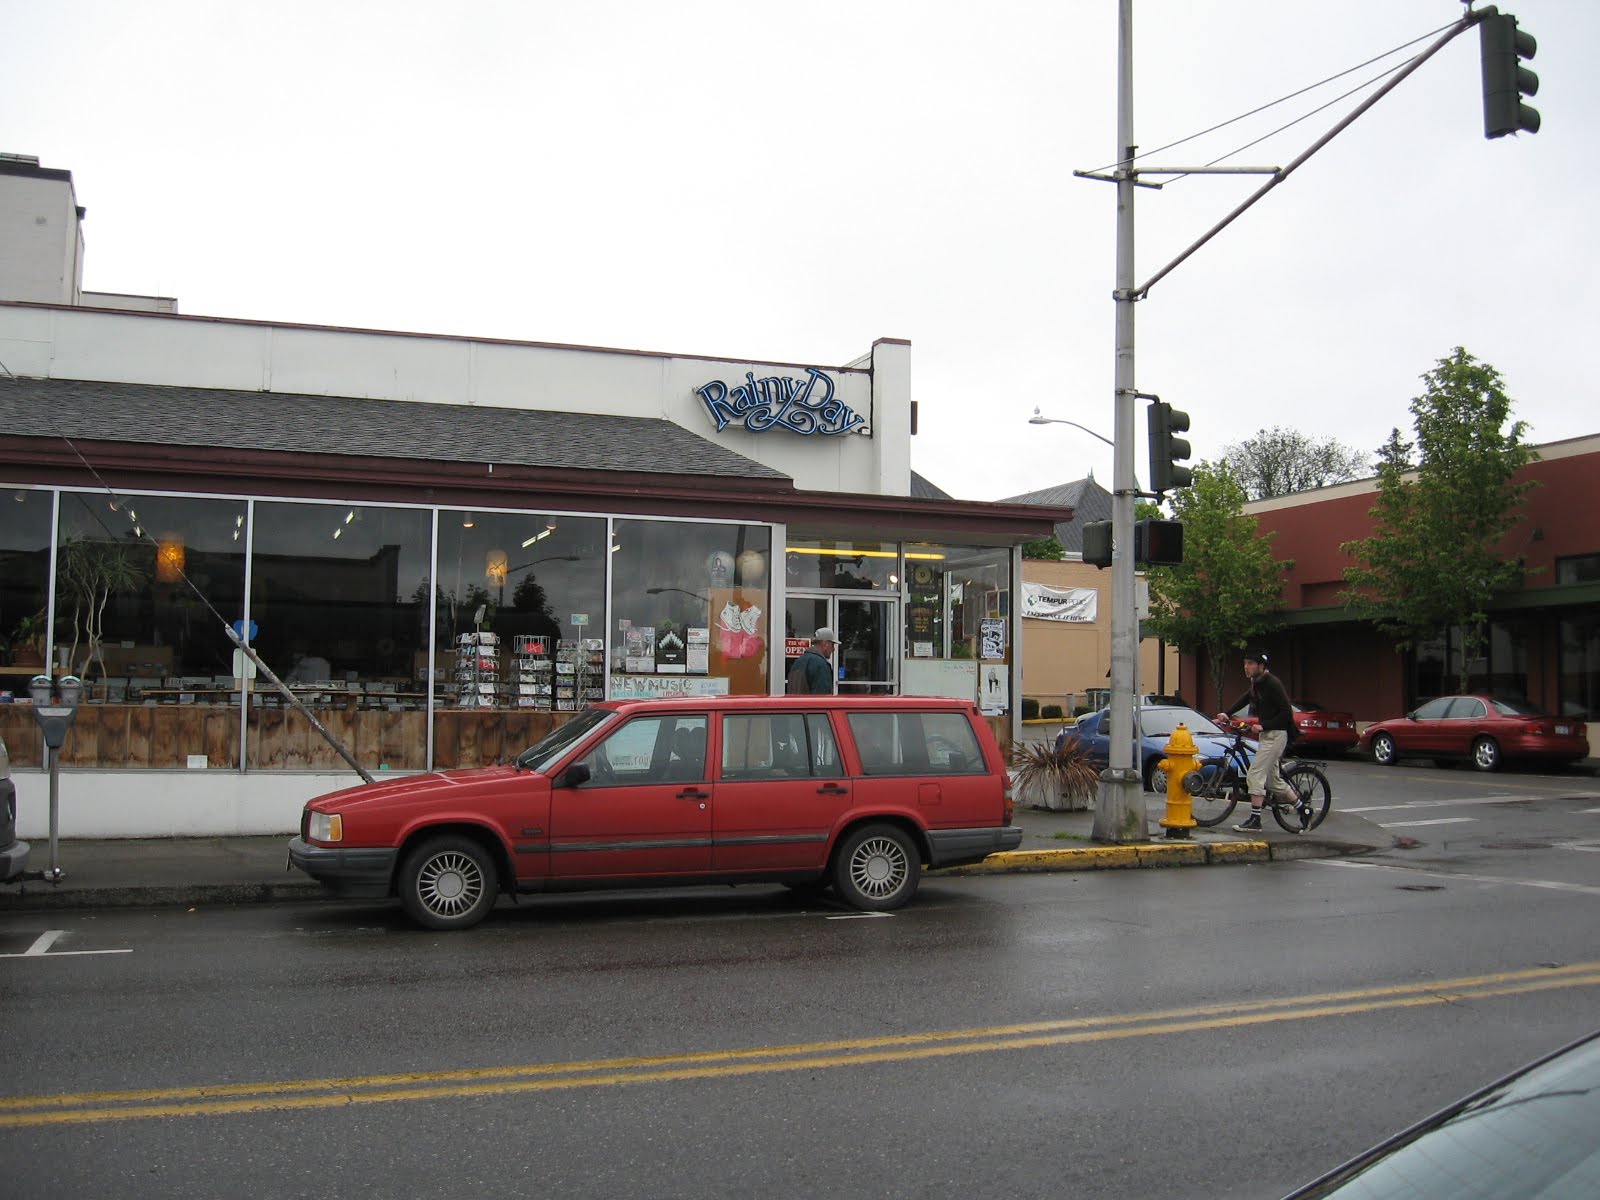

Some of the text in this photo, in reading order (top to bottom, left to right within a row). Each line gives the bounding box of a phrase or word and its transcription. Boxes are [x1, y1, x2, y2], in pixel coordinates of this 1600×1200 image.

[696, 367, 865, 436] Rainy Day
[1038, 595, 1067, 605] TEMPUR
[611, 677, 647, 691] NEW
